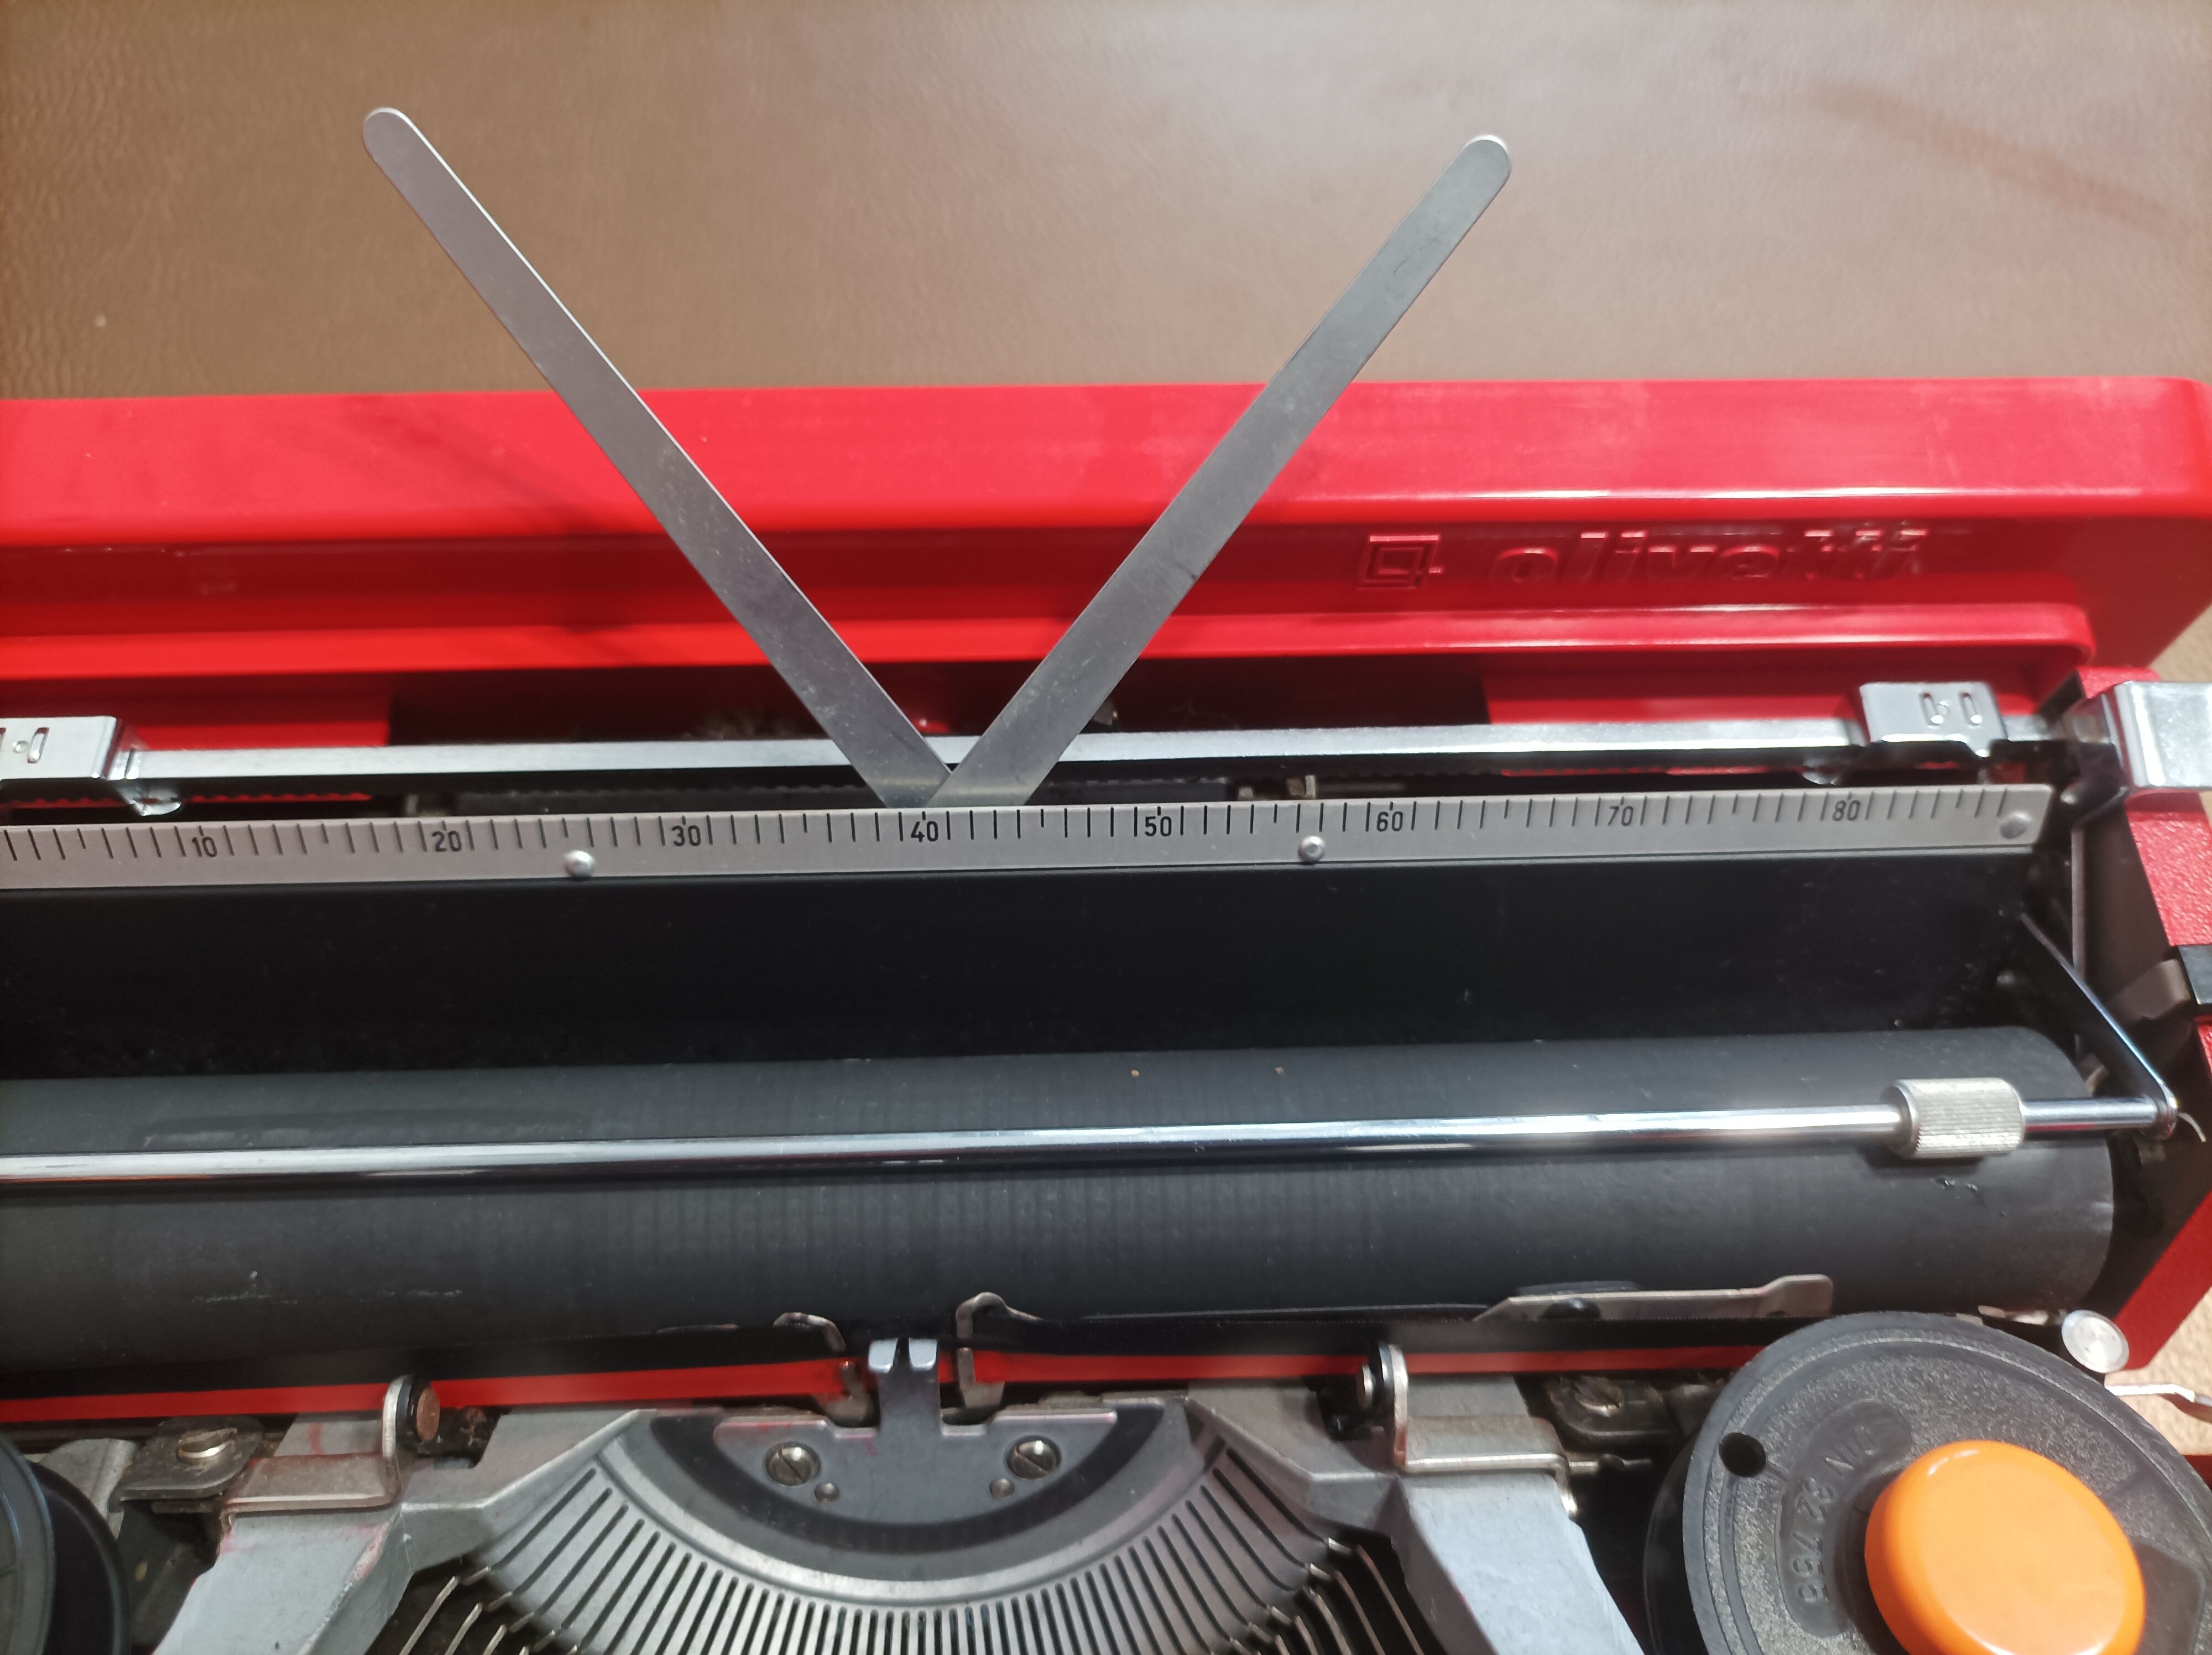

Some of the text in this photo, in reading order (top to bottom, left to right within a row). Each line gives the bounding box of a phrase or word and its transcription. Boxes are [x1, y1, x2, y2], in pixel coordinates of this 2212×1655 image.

[1490, 528, 1927, 585] olivetti
[191, 800, 1861, 857] 10 20 30 40 50 60 70 80
[1792, 1424, 1877, 1602] DIN 32 755
